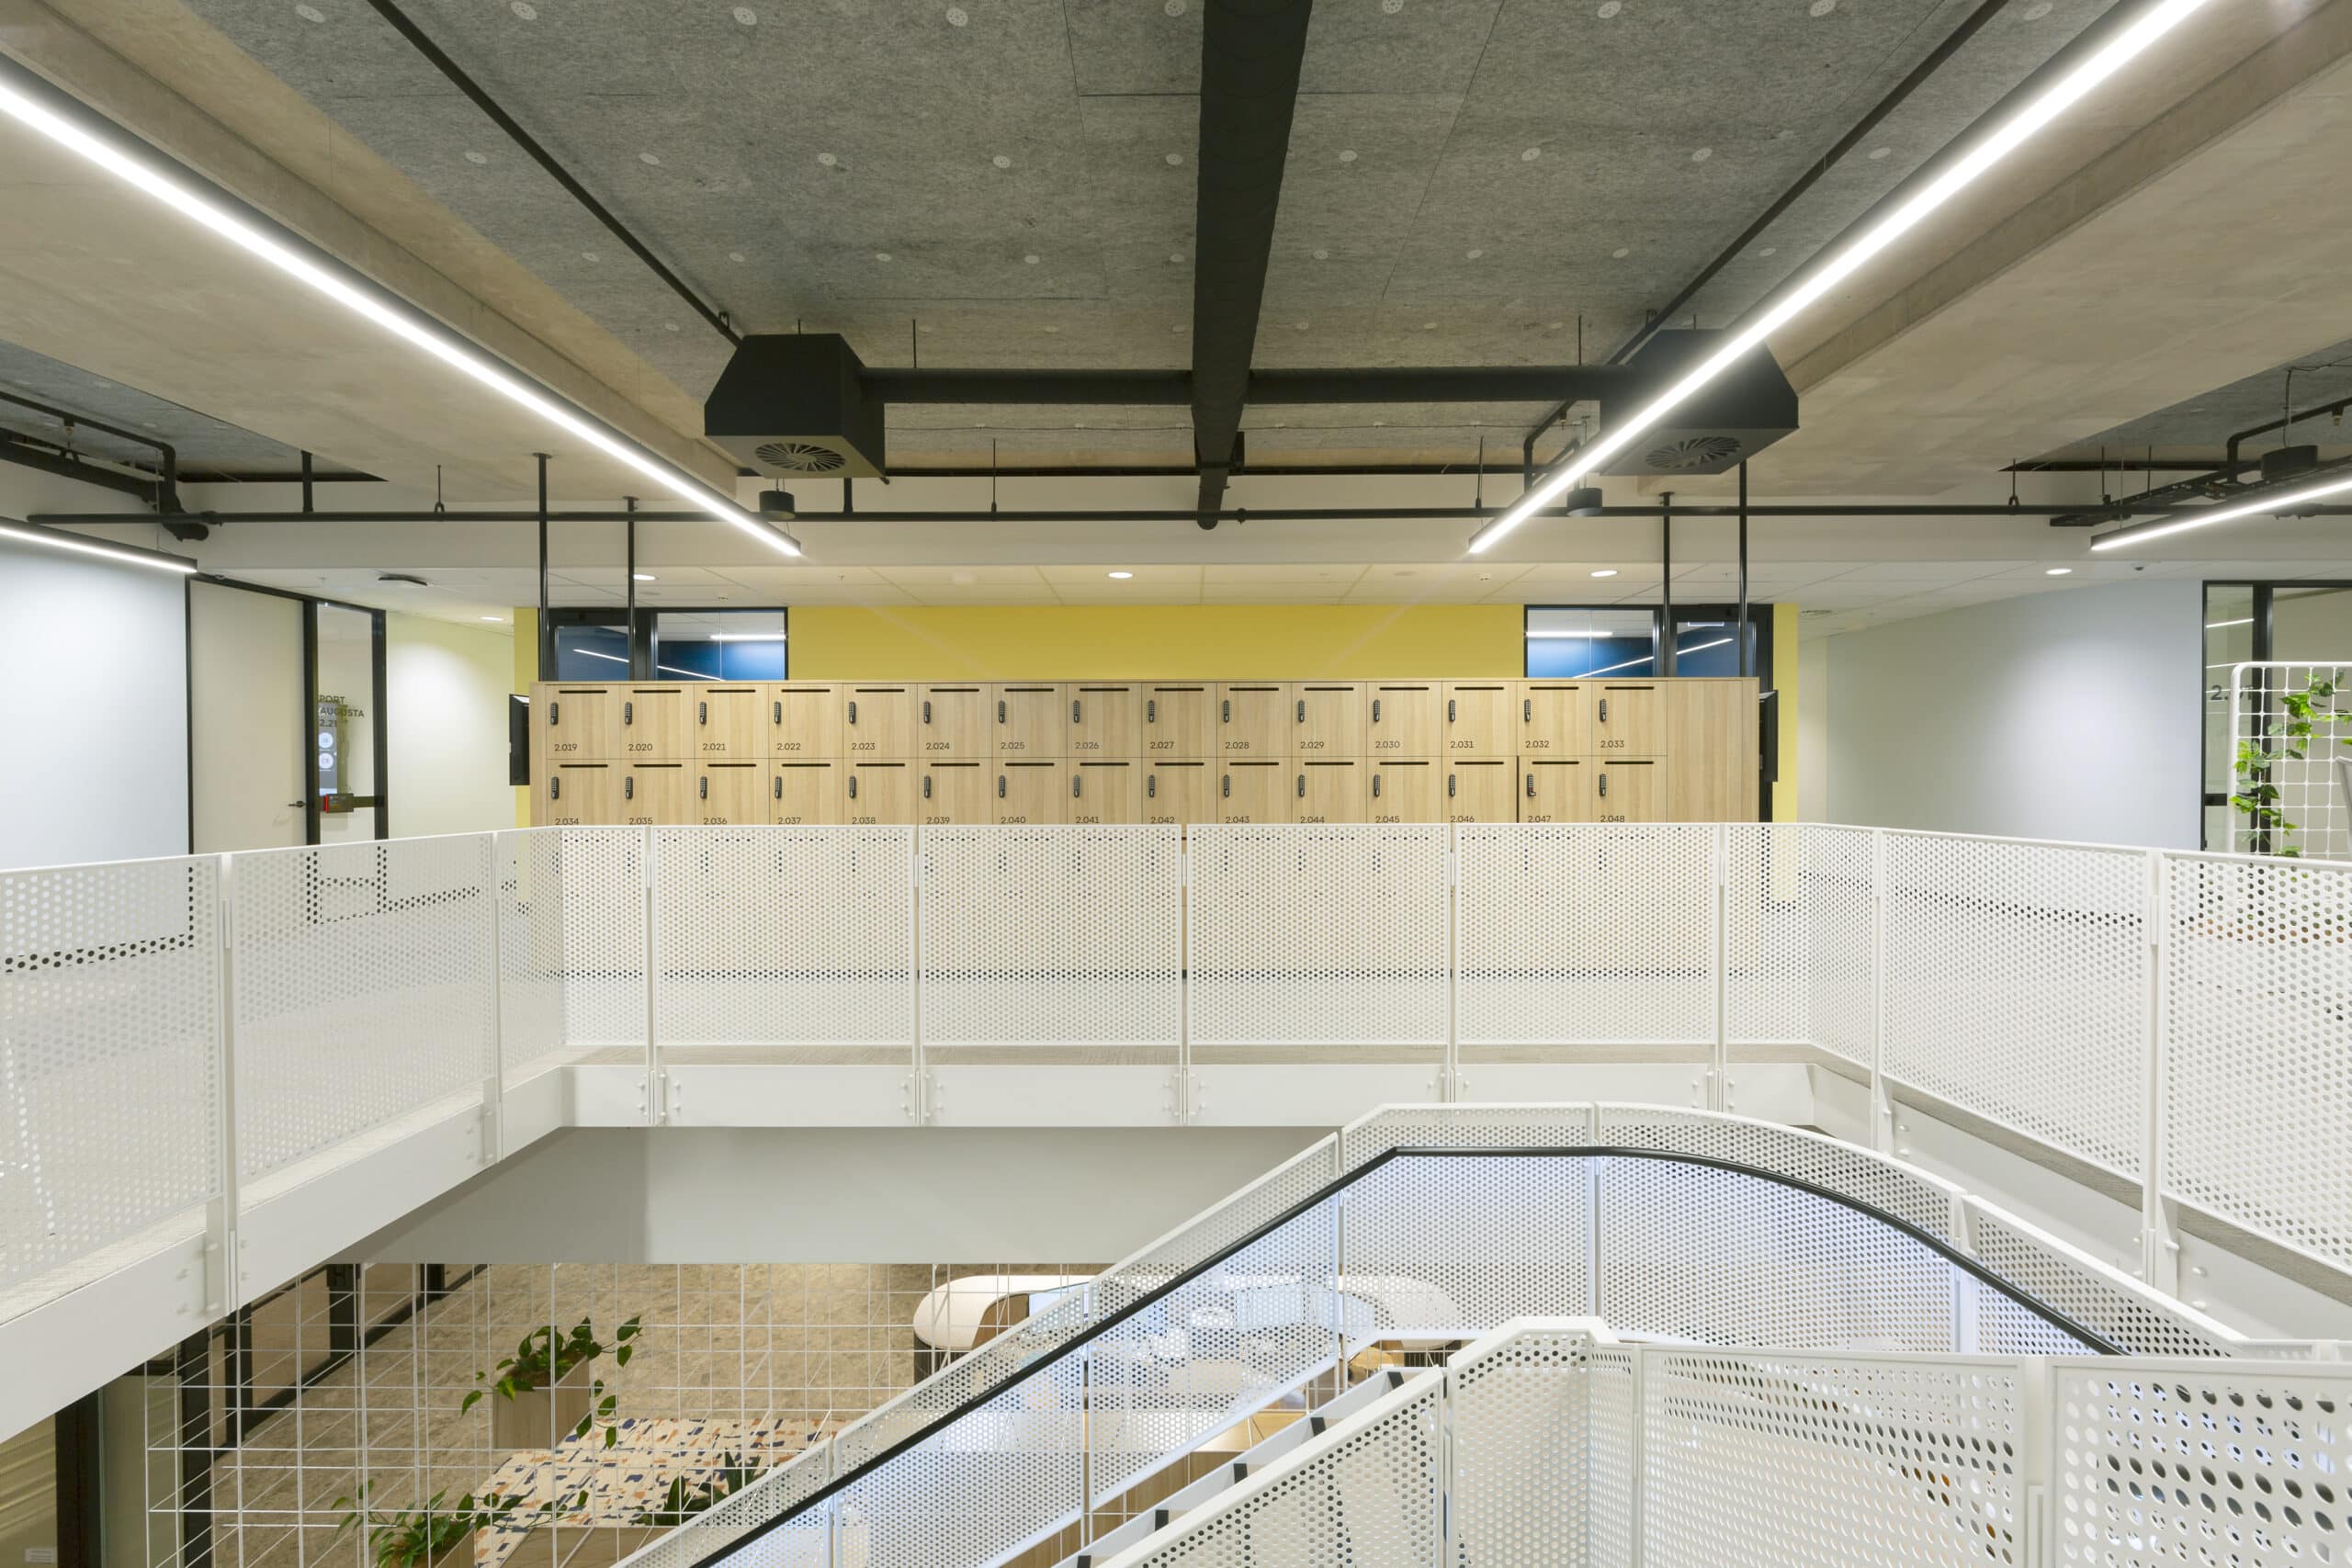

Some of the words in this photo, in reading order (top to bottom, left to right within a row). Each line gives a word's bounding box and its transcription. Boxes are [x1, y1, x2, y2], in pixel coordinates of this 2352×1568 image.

[319, 694, 345, 705] PORT
[320, 705, 365, 717] AUGUSTA
[554, 742, 578, 752] 2.019
[628, 742, 653, 752] 2.020
[702, 742, 727, 752] 2.021
[776, 741, 801, 751] 2.022
[851, 741, 876, 751] 2.023
[925, 741, 950, 751] 2.024
[1000, 741, 1025, 751] 2.025
[1075, 741, 1100, 751] 2.026
[1149, 740, 1175, 750] 2.027
[1225, 740, 1250, 750] 2.028
[1300, 740, 1325, 750] 2.029
[1374, 740, 1401, 750] 2.030
[1450, 739, 1475, 750] 2.031
[1524, 739, 1550, 750] 2.032
[1600, 739, 1625, 750] 2.033
[554, 817, 580, 825] 2.034
[628, 816, 653, 825] 2.035
[703, 816, 728, 825] 2.036
[777, 816, 802, 825] 2.037
[852, 816, 876, 825] 2.038
[926, 816, 951, 825] 2.039
[1001, 815, 1026, 825] 2.040
[1075, 815, 1101, 825] 2.041
[1150, 815, 1175, 825] 2.042
[1225, 815, 1250, 825] 2.043
[1299, 815, 1325, 823] 2.044
[1374, 815, 1400, 823] 2.045
[1450, 814, 1476, 823] 2.046
[1527, 814, 1552, 823] 2.047
[1600, 814, 1625, 823] 2.048
